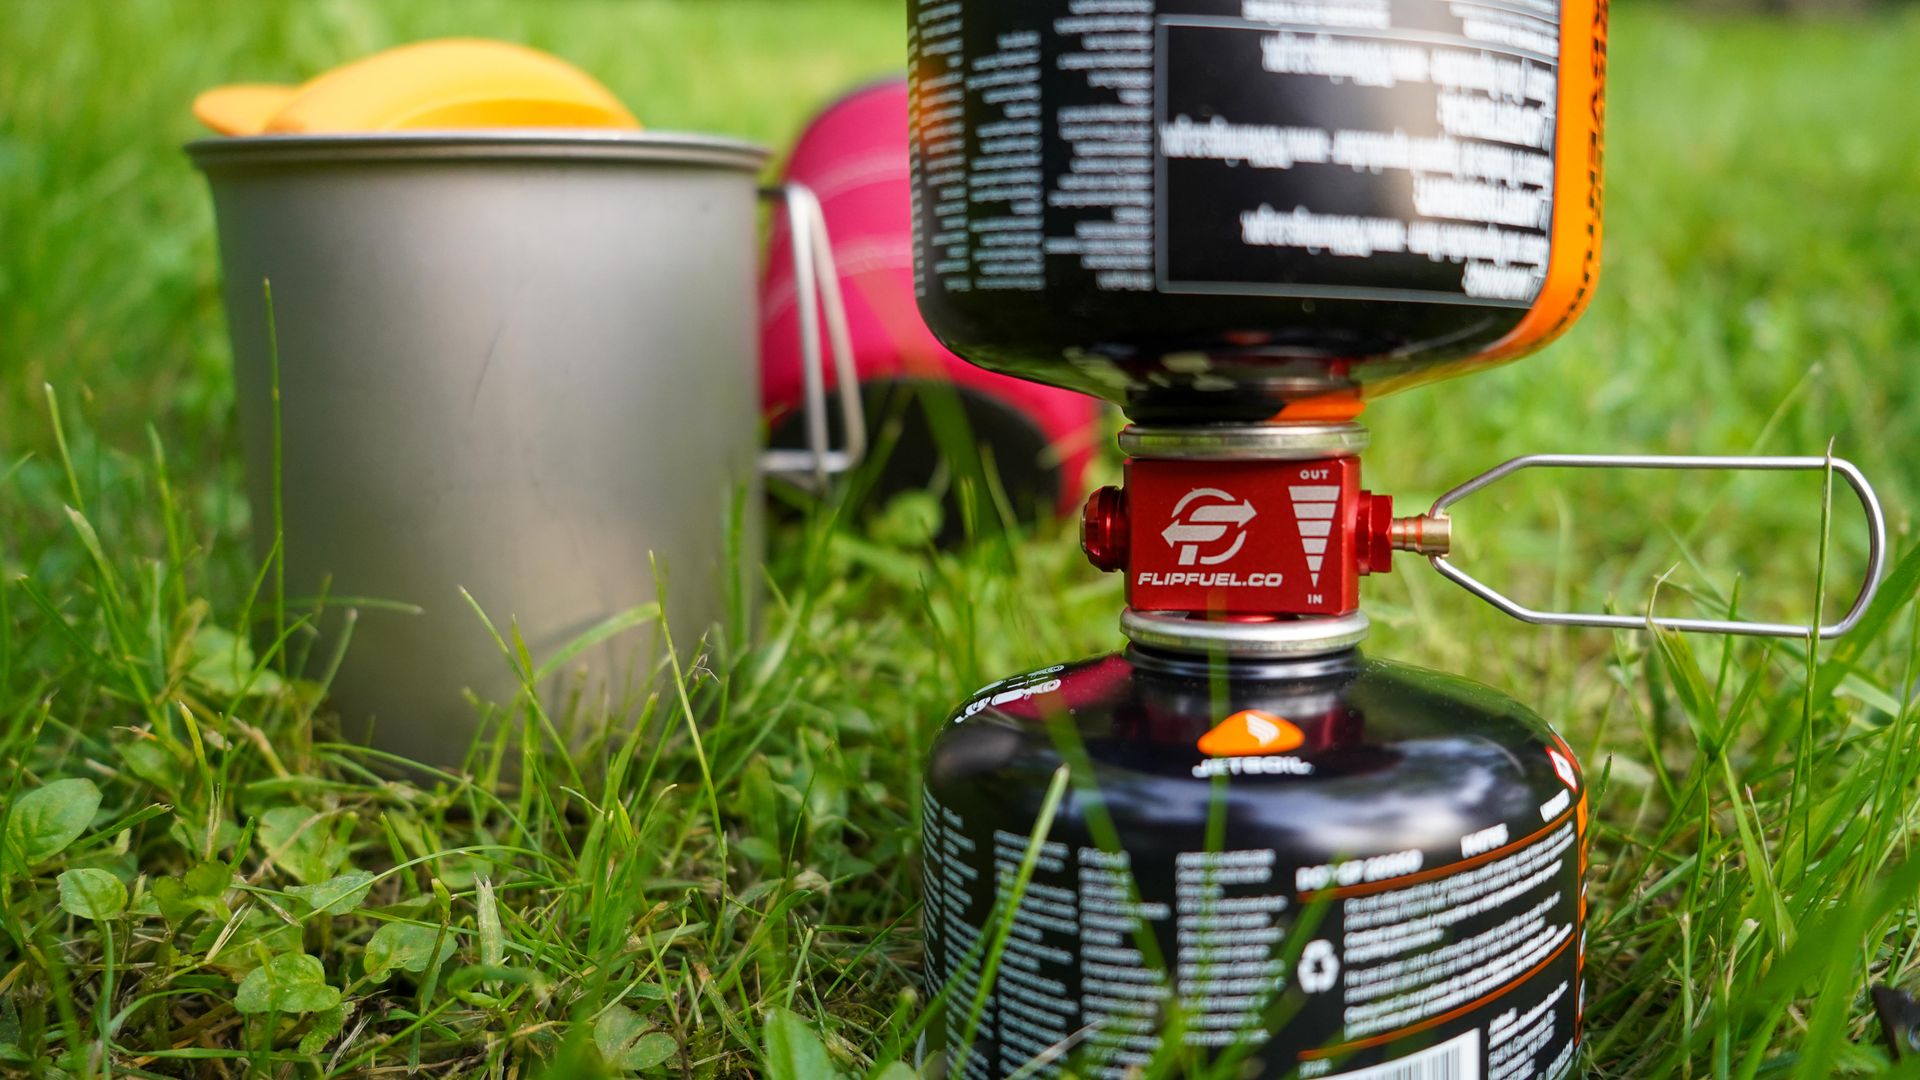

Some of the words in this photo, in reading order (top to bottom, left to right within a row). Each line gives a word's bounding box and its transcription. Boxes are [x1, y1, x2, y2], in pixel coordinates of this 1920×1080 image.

[1299, 469, 1329, 480] OUT
[1137, 572, 1284, 587] FLIPFUEL.CO
[1307, 594, 1323, 604] IN
